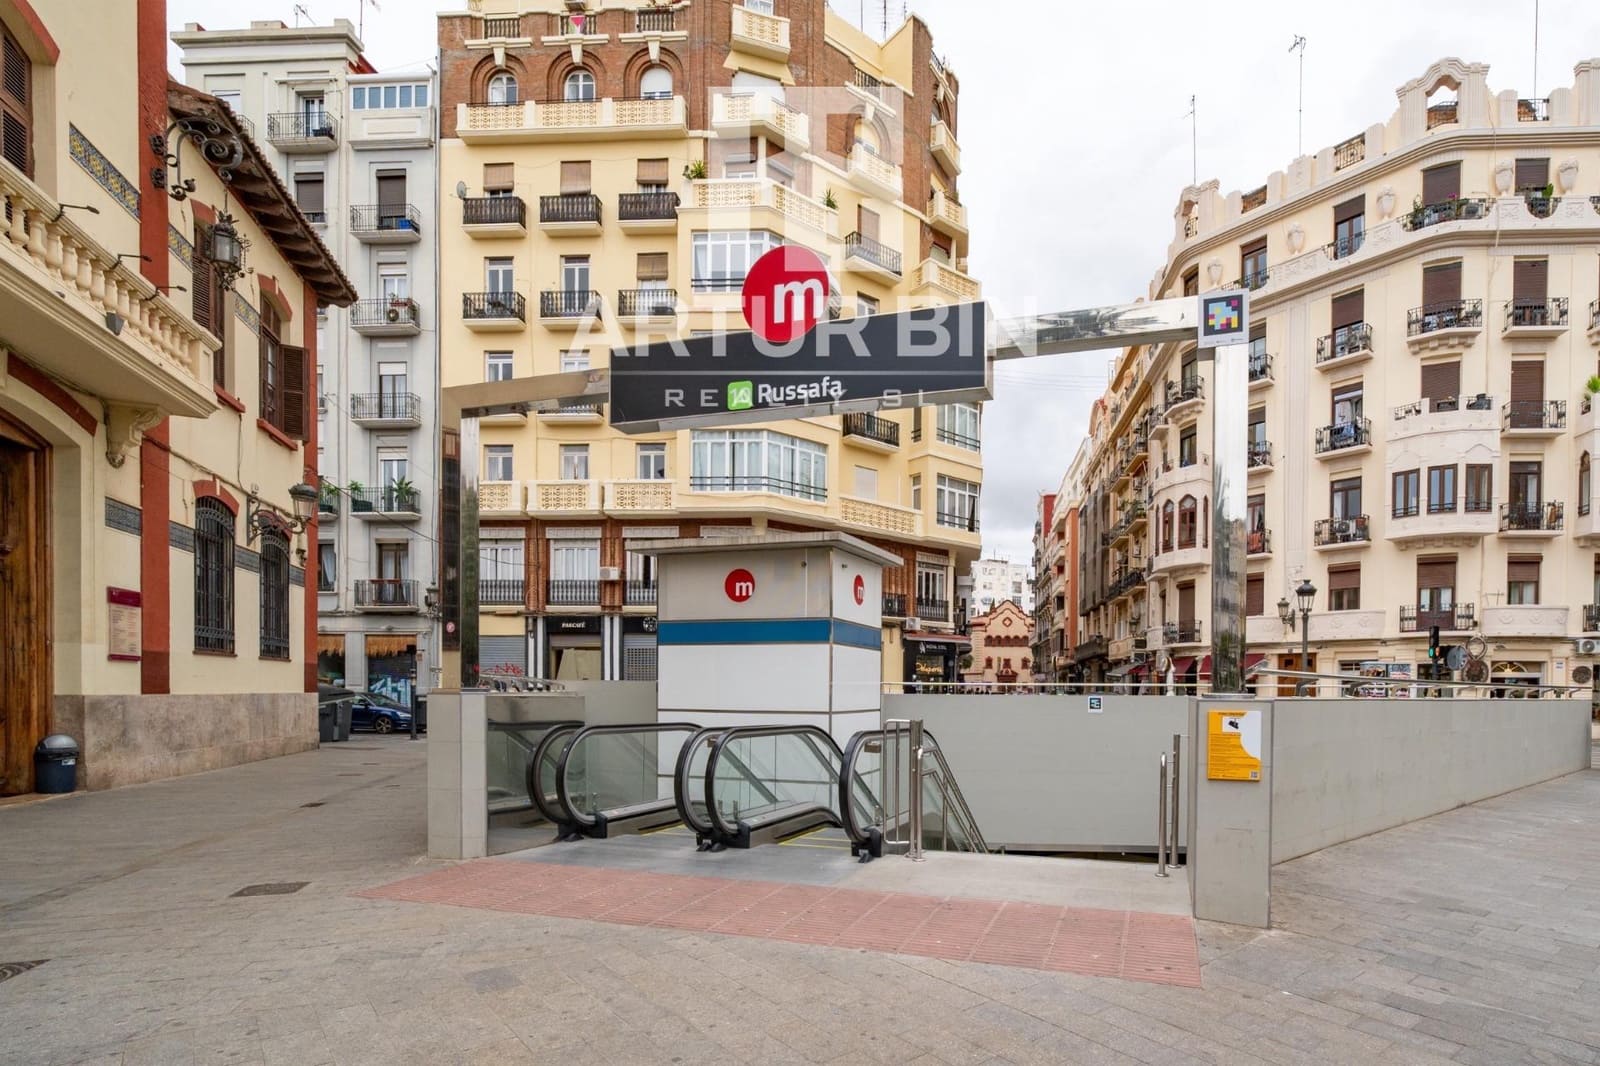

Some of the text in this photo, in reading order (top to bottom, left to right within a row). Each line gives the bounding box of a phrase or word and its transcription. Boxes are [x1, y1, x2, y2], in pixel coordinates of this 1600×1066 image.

[774, 278, 823, 325] m
[758, 376, 841, 403] Russafa
[735, 581, 752, 596] m
